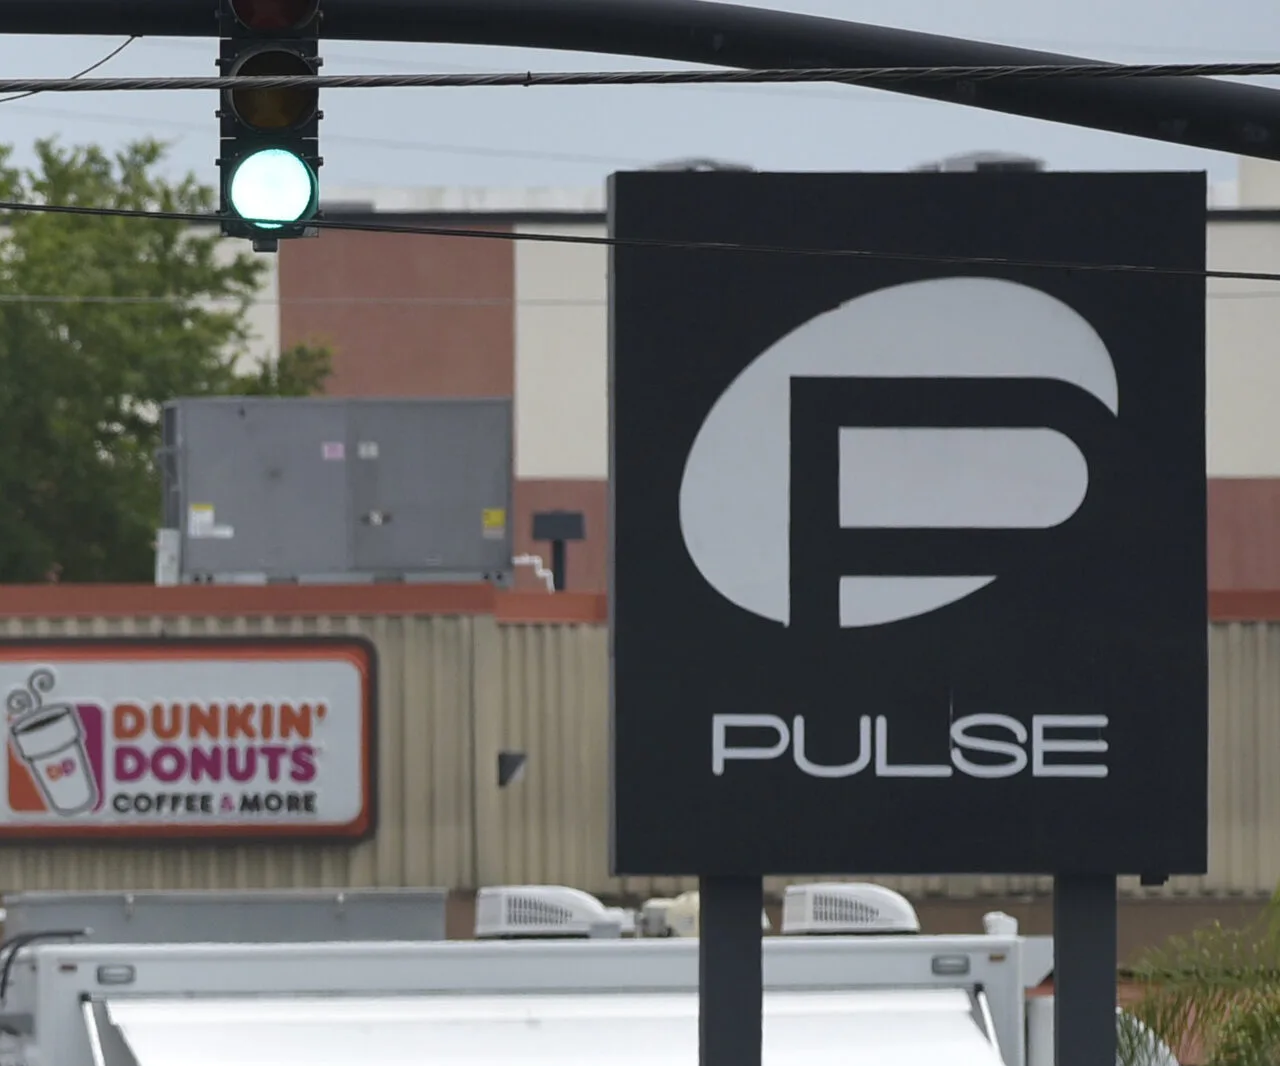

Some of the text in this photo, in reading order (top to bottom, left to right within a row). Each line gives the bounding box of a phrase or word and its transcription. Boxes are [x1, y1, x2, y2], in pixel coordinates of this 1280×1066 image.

[112, 703, 327, 740] DUNKIN'
[114, 744, 318, 783] DONUTS
[712, 713, 1109, 778] PULSE
[112, 793, 214, 813] COFFEE
[239, 793, 317, 813] MORE
